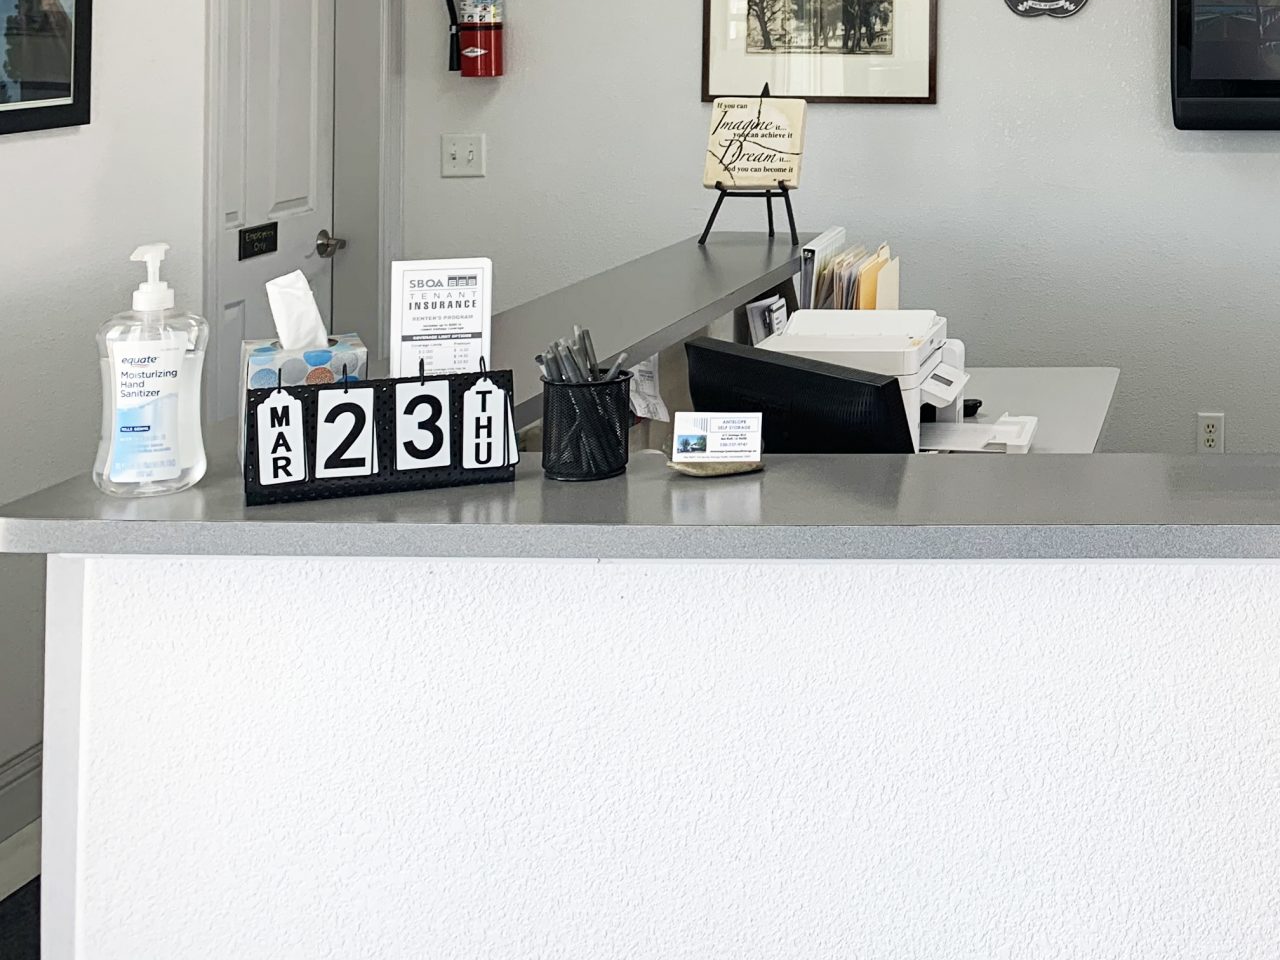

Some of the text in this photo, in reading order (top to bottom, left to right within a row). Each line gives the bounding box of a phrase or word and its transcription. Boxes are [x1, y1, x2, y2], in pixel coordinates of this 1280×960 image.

[712, 110, 774, 138] Imagine
[719, 139, 777, 164] Dream
[409, 279, 444, 289] SBOA
[410, 290, 478, 300] TENANT
[409, 300, 477, 310] INSURANCE
[121, 356, 157, 365] equate
[120, 370, 178, 379] Moisturizing
[120, 389, 160, 398] Sanitizer
